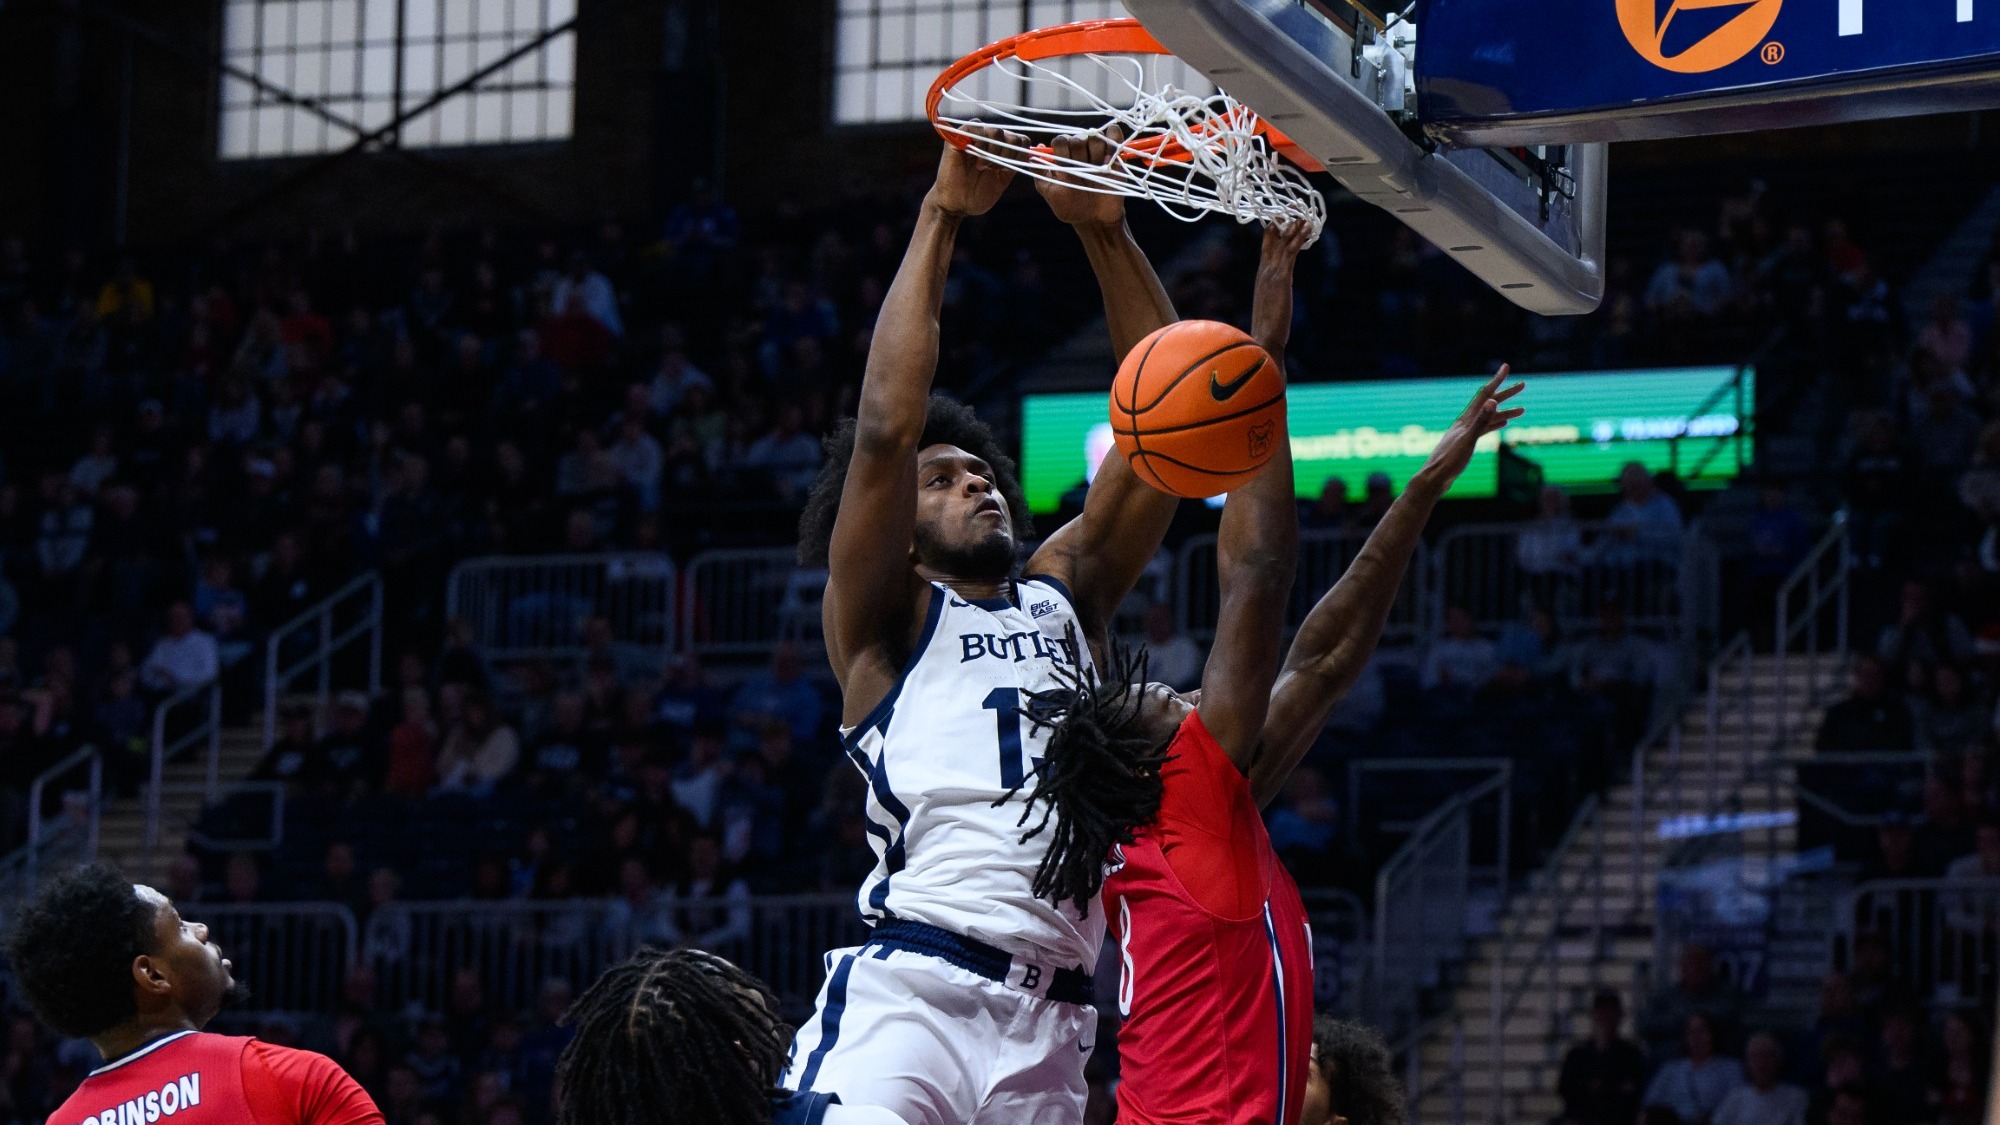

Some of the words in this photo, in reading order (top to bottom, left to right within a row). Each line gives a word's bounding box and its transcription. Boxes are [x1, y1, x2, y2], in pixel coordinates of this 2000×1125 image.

[1030, 600, 1050, 612] BIG
[1031, 603, 1059, 617] EAST
[1019, 963, 1042, 989] B
[74, 1071, 200, 1125] BINSON
